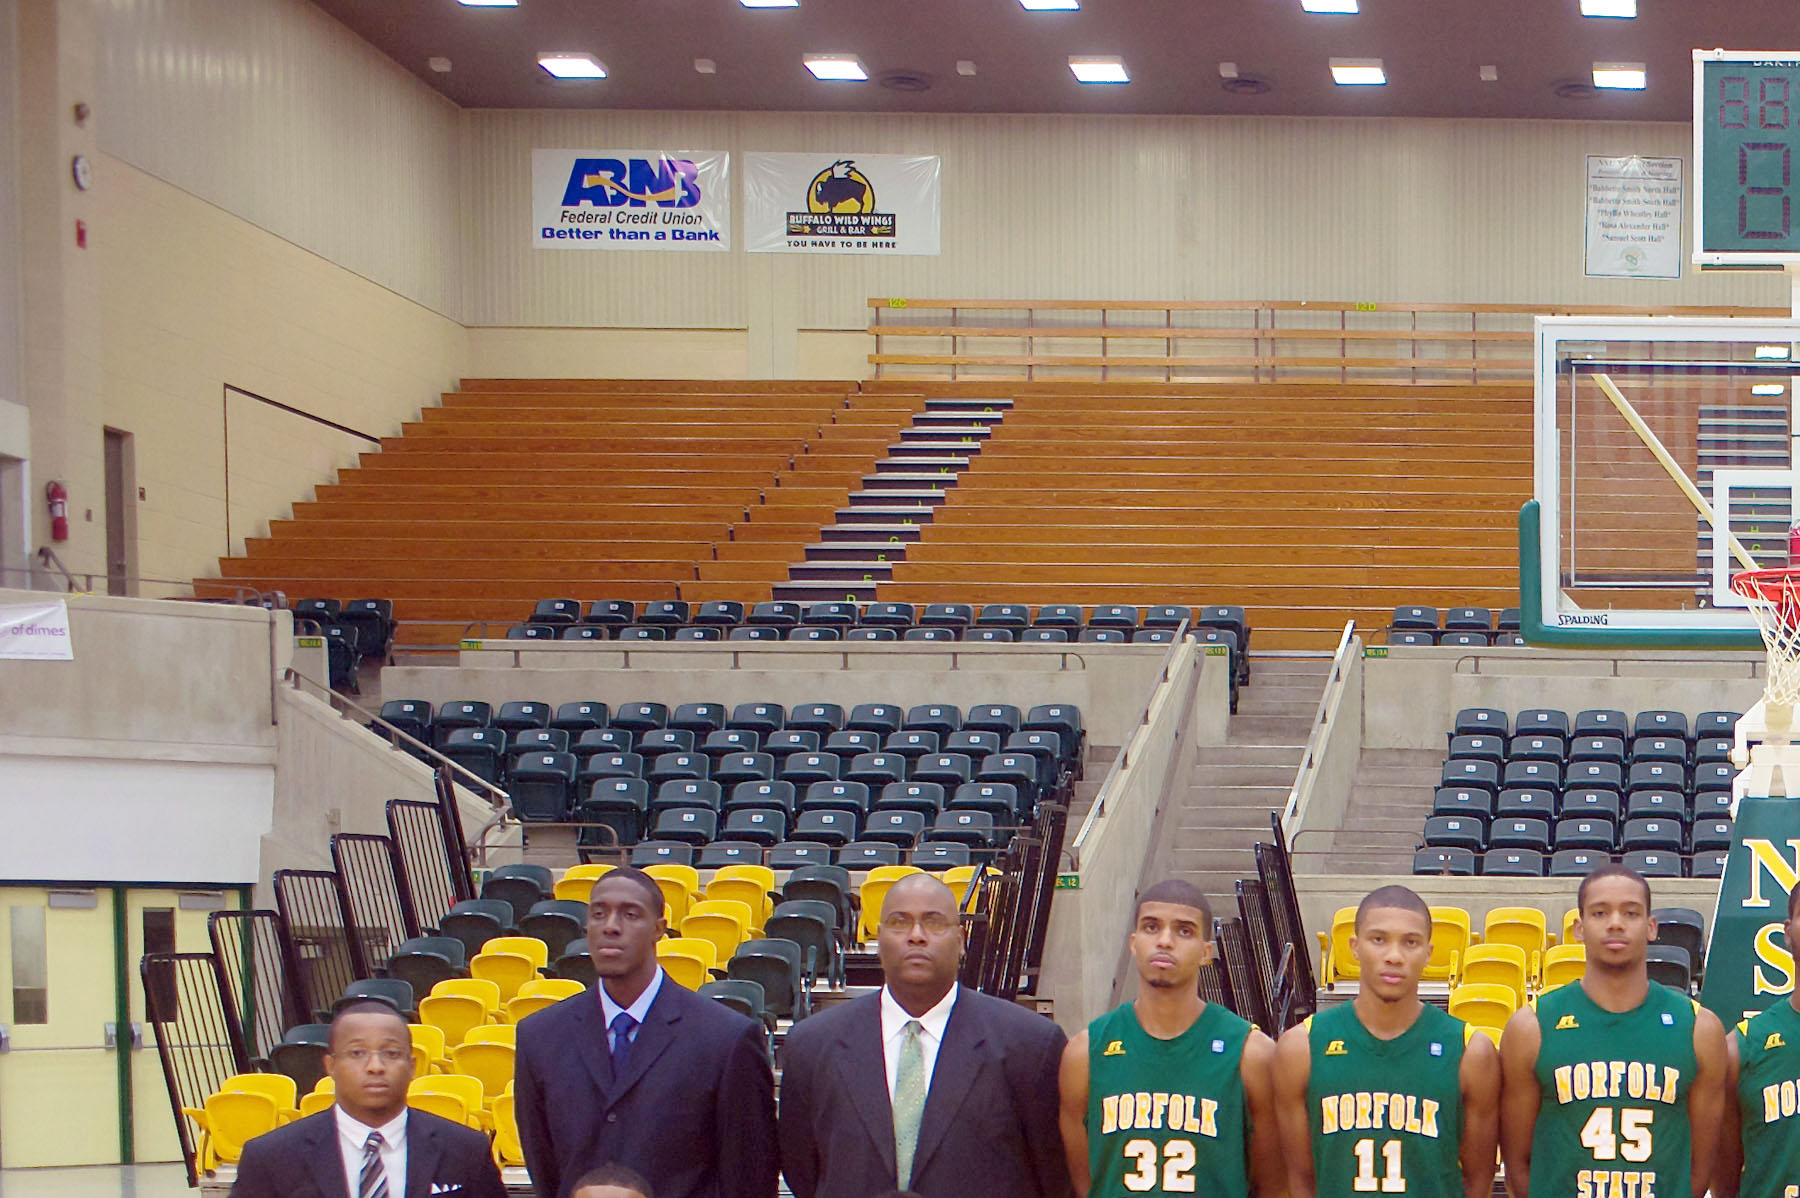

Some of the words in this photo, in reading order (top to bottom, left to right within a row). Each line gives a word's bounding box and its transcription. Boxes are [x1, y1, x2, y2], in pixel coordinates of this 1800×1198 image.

[561, 158, 702, 208] ABNB
[560, 210, 612, 224] Federal
[616, 210, 658, 224] Credit
[662, 211, 703, 225] Union
[789, 214, 832, 225] BUFFALO
[833, 215, 860, 226] WILD
[860, 215, 893, 226] WINGS
[816, 226, 839, 234] GRILL
[848, 226, 866, 235] BAR
[541, 227, 603, 240] Better
[608, 228, 650, 240] than
[654, 230, 667, 241] a
[671, 229, 721, 241] Bank
[787, 240, 807, 248] YOU
[811, 240, 836, 248] HAVE
[871, 241, 897, 249] HERE
[11, 623, 25, 636] of
[26, 623, 67, 637] dimes
[1558, 614, 1608, 626] SPALDING
[1554, 1061, 1680, 1105] NORFOLK
[1101, 1092, 1218, 1137] NORFOLK
[1321, 1092, 1439, 1138] NORFOLK
[1580, 1107, 1654, 1162] 45
[1123, 1139, 1197, 1192] 32
[1353, 1139, 1406, 1193] 11
